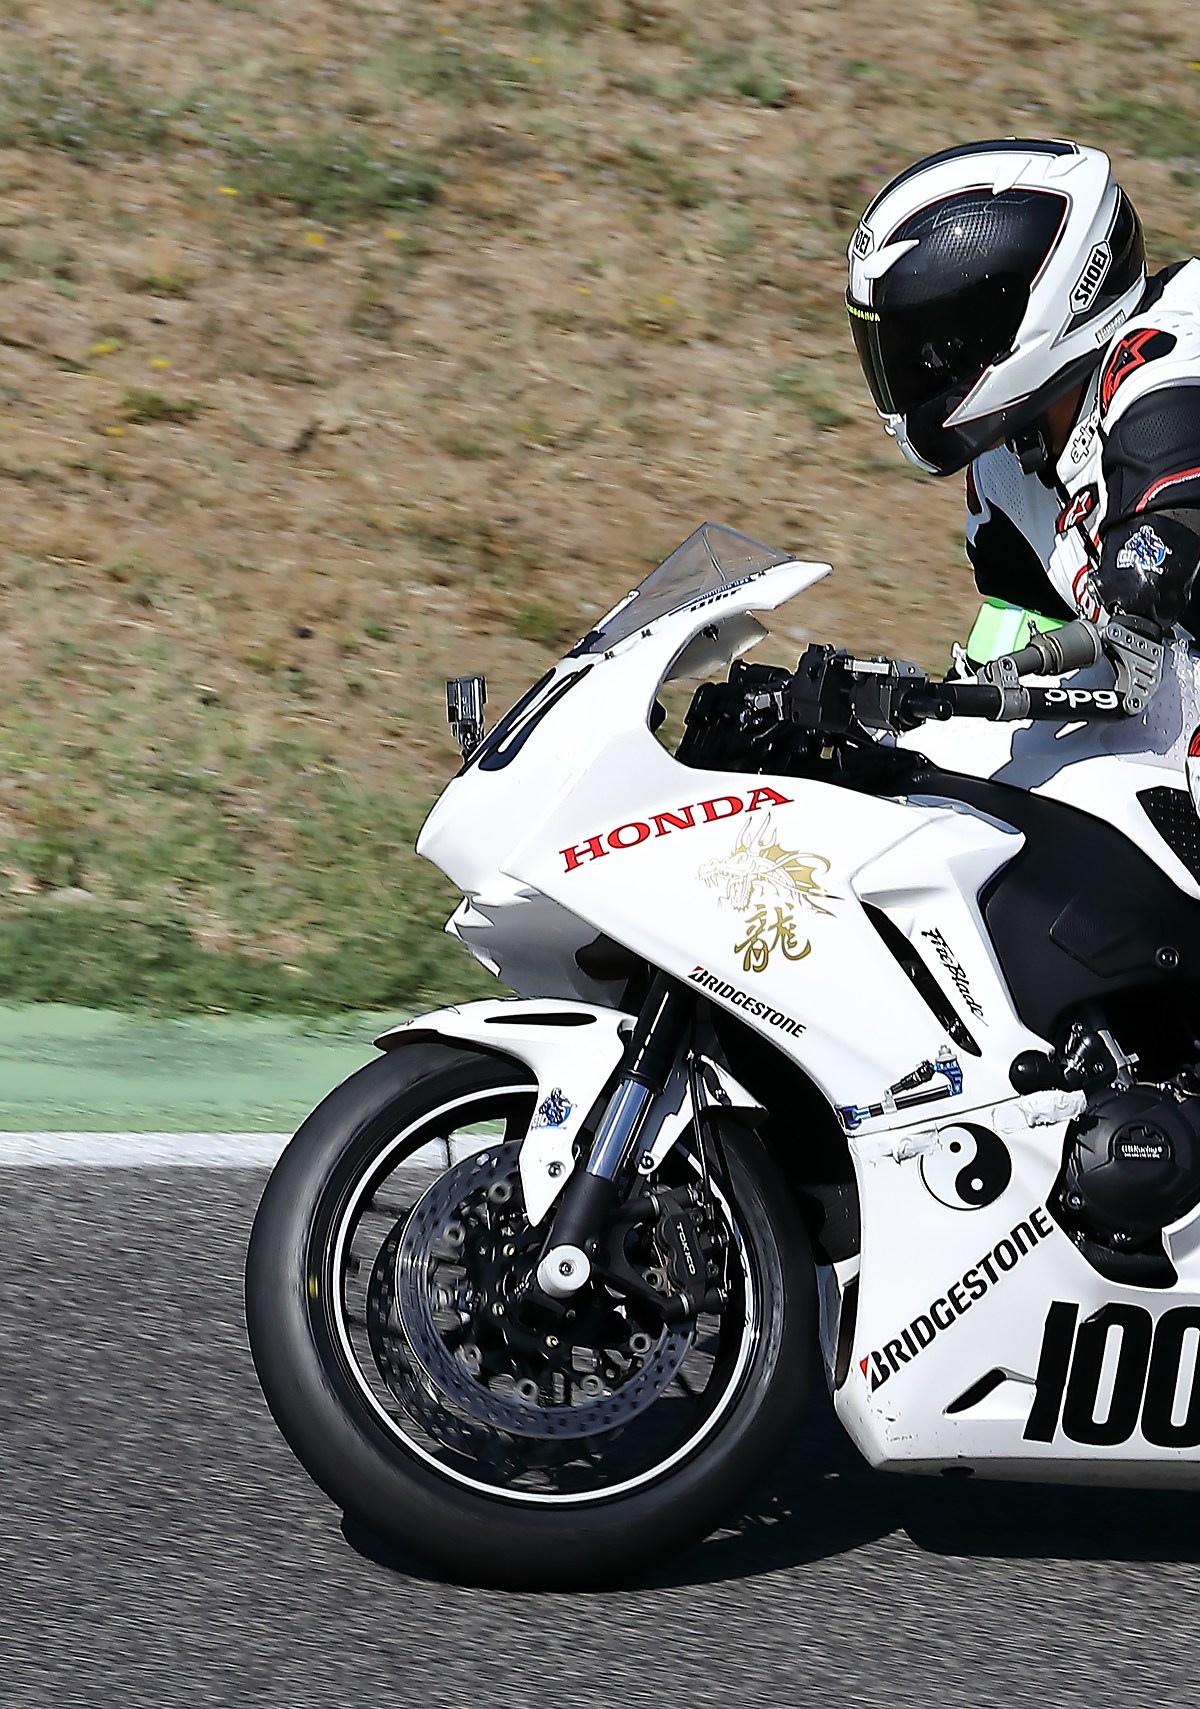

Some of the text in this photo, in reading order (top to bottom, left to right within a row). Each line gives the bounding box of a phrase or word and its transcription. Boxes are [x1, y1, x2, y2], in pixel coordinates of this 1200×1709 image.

[1074, 248, 1108, 305] SHOEI
[559, 787, 794, 873] HONDA
[687, 966, 807, 1038] BRIDGESTONE
[859, 1206, 1054, 1393] BRIDGESTONE
